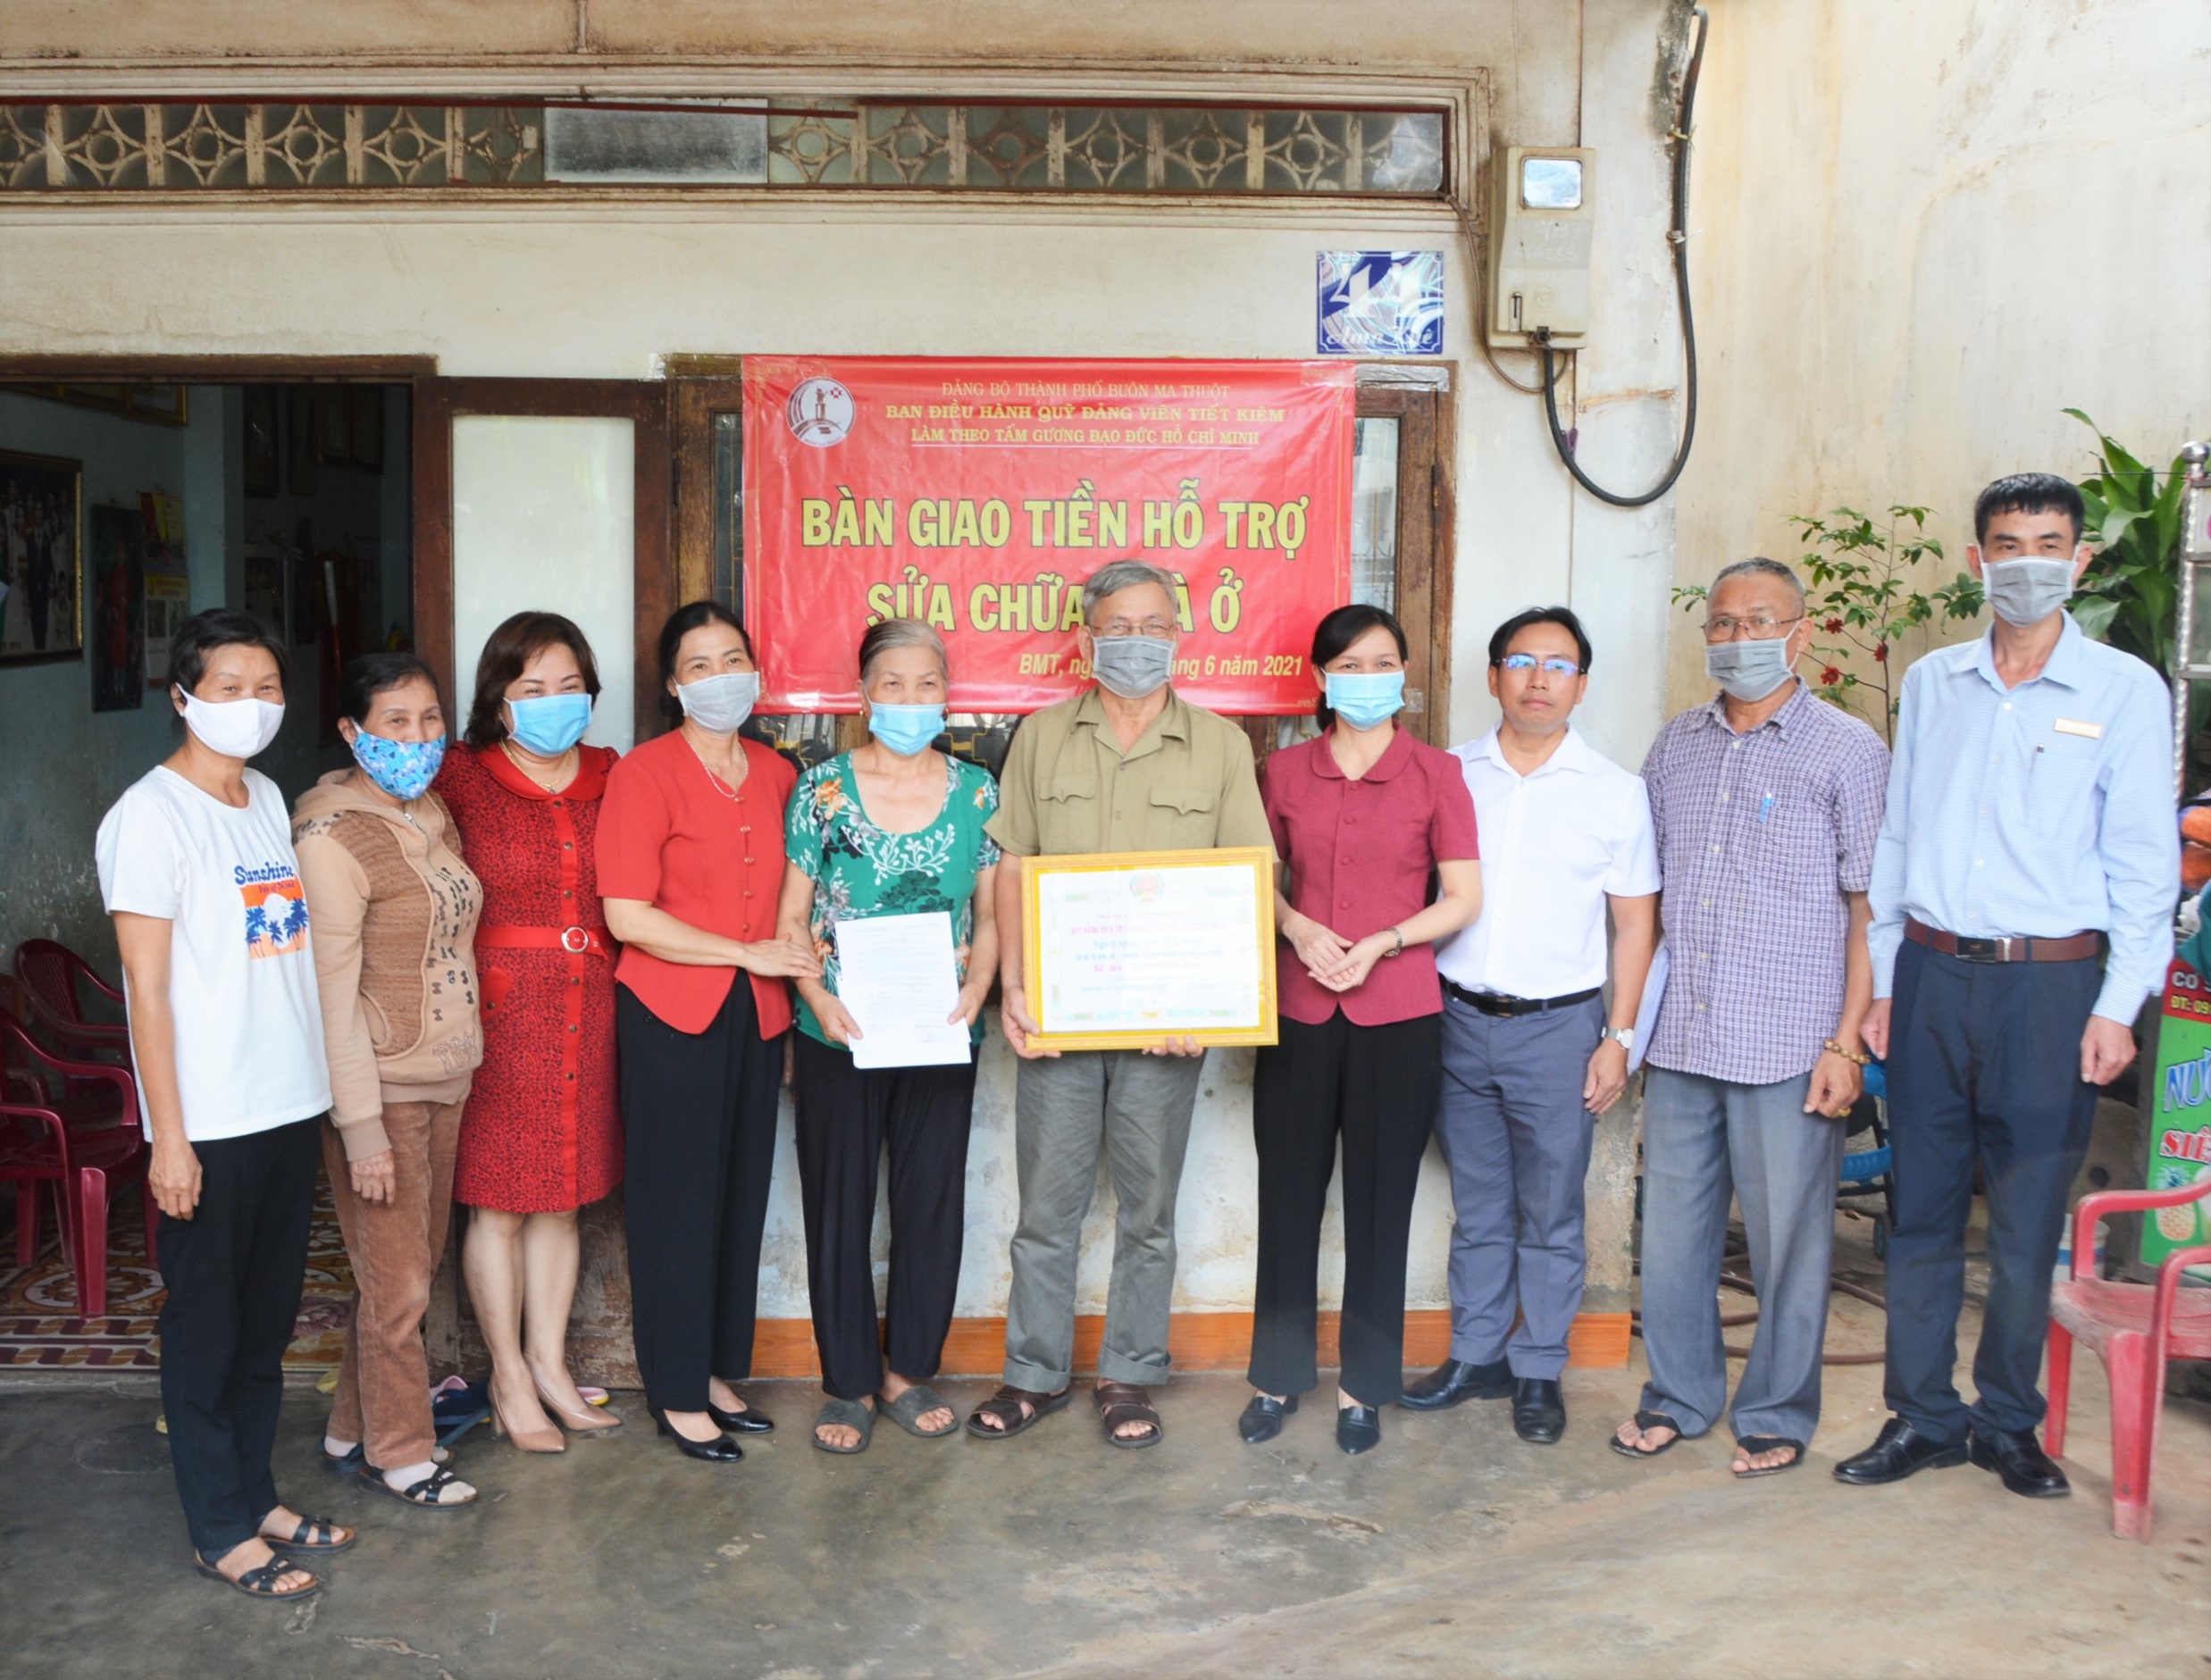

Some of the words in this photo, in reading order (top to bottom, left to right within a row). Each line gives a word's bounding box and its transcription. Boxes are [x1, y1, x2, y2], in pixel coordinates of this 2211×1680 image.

[942, 379, 984, 396] ĐẢNG
[990, 382, 1011, 398] BỘ
[1017, 380, 1067, 397] THÀNH
[1073, 380, 1103, 397] PHỐ
[1109, 383, 1149, 397] BUÔN
[1154, 384, 1177, 398] MA
[1180, 382, 1230, 400] THUỘT
[886, 405, 923, 419] BAN
[929, 399, 974, 419] ĐIỀU
[980, 403, 1031, 419] HÀNH
[1037, 404, 1076, 422] QUỸ
[1082, 402, 1133, 420] ĐẢNG
[1138, 405, 1182, 421] VIÊN
[1188, 403, 1231, 422] TIẾT
[1236, 406, 1285, 425] KIỆM
[911, 425, 944, 442] LÀM
[949, 429, 990, 442] THEO
[994, 423, 1027, 443] TẤM
[1033, 428, 1085, 443] GƯƠNG
[1090, 429, 1120, 445] ĐẠO
[1126, 427, 1157, 443] ĐỨC
[1162, 424, 1183, 444] HỒ
[1187, 430, 1215, 444] CHÍ
[1219, 431, 1260, 445] MINH
[801, 485, 894, 547] BÀN
[908, 498, 1011, 547] GIAO
[1023, 479, 1128, 548] TIỀN
[1143, 477, 1205, 549] HỖ
[1218, 495, 1310, 560] TRỢ
[866, 564, 957, 631] SỬA
[969, 572, 1085, 632] CHỮA
[1210, 566, 1244, 634] Ở
[1019, 653, 1063, 678] BMT,
[1205, 655, 1216, 676] 6
[1220, 654, 1258, 676] năm
[1262, 655, 1302, 676] 2021
